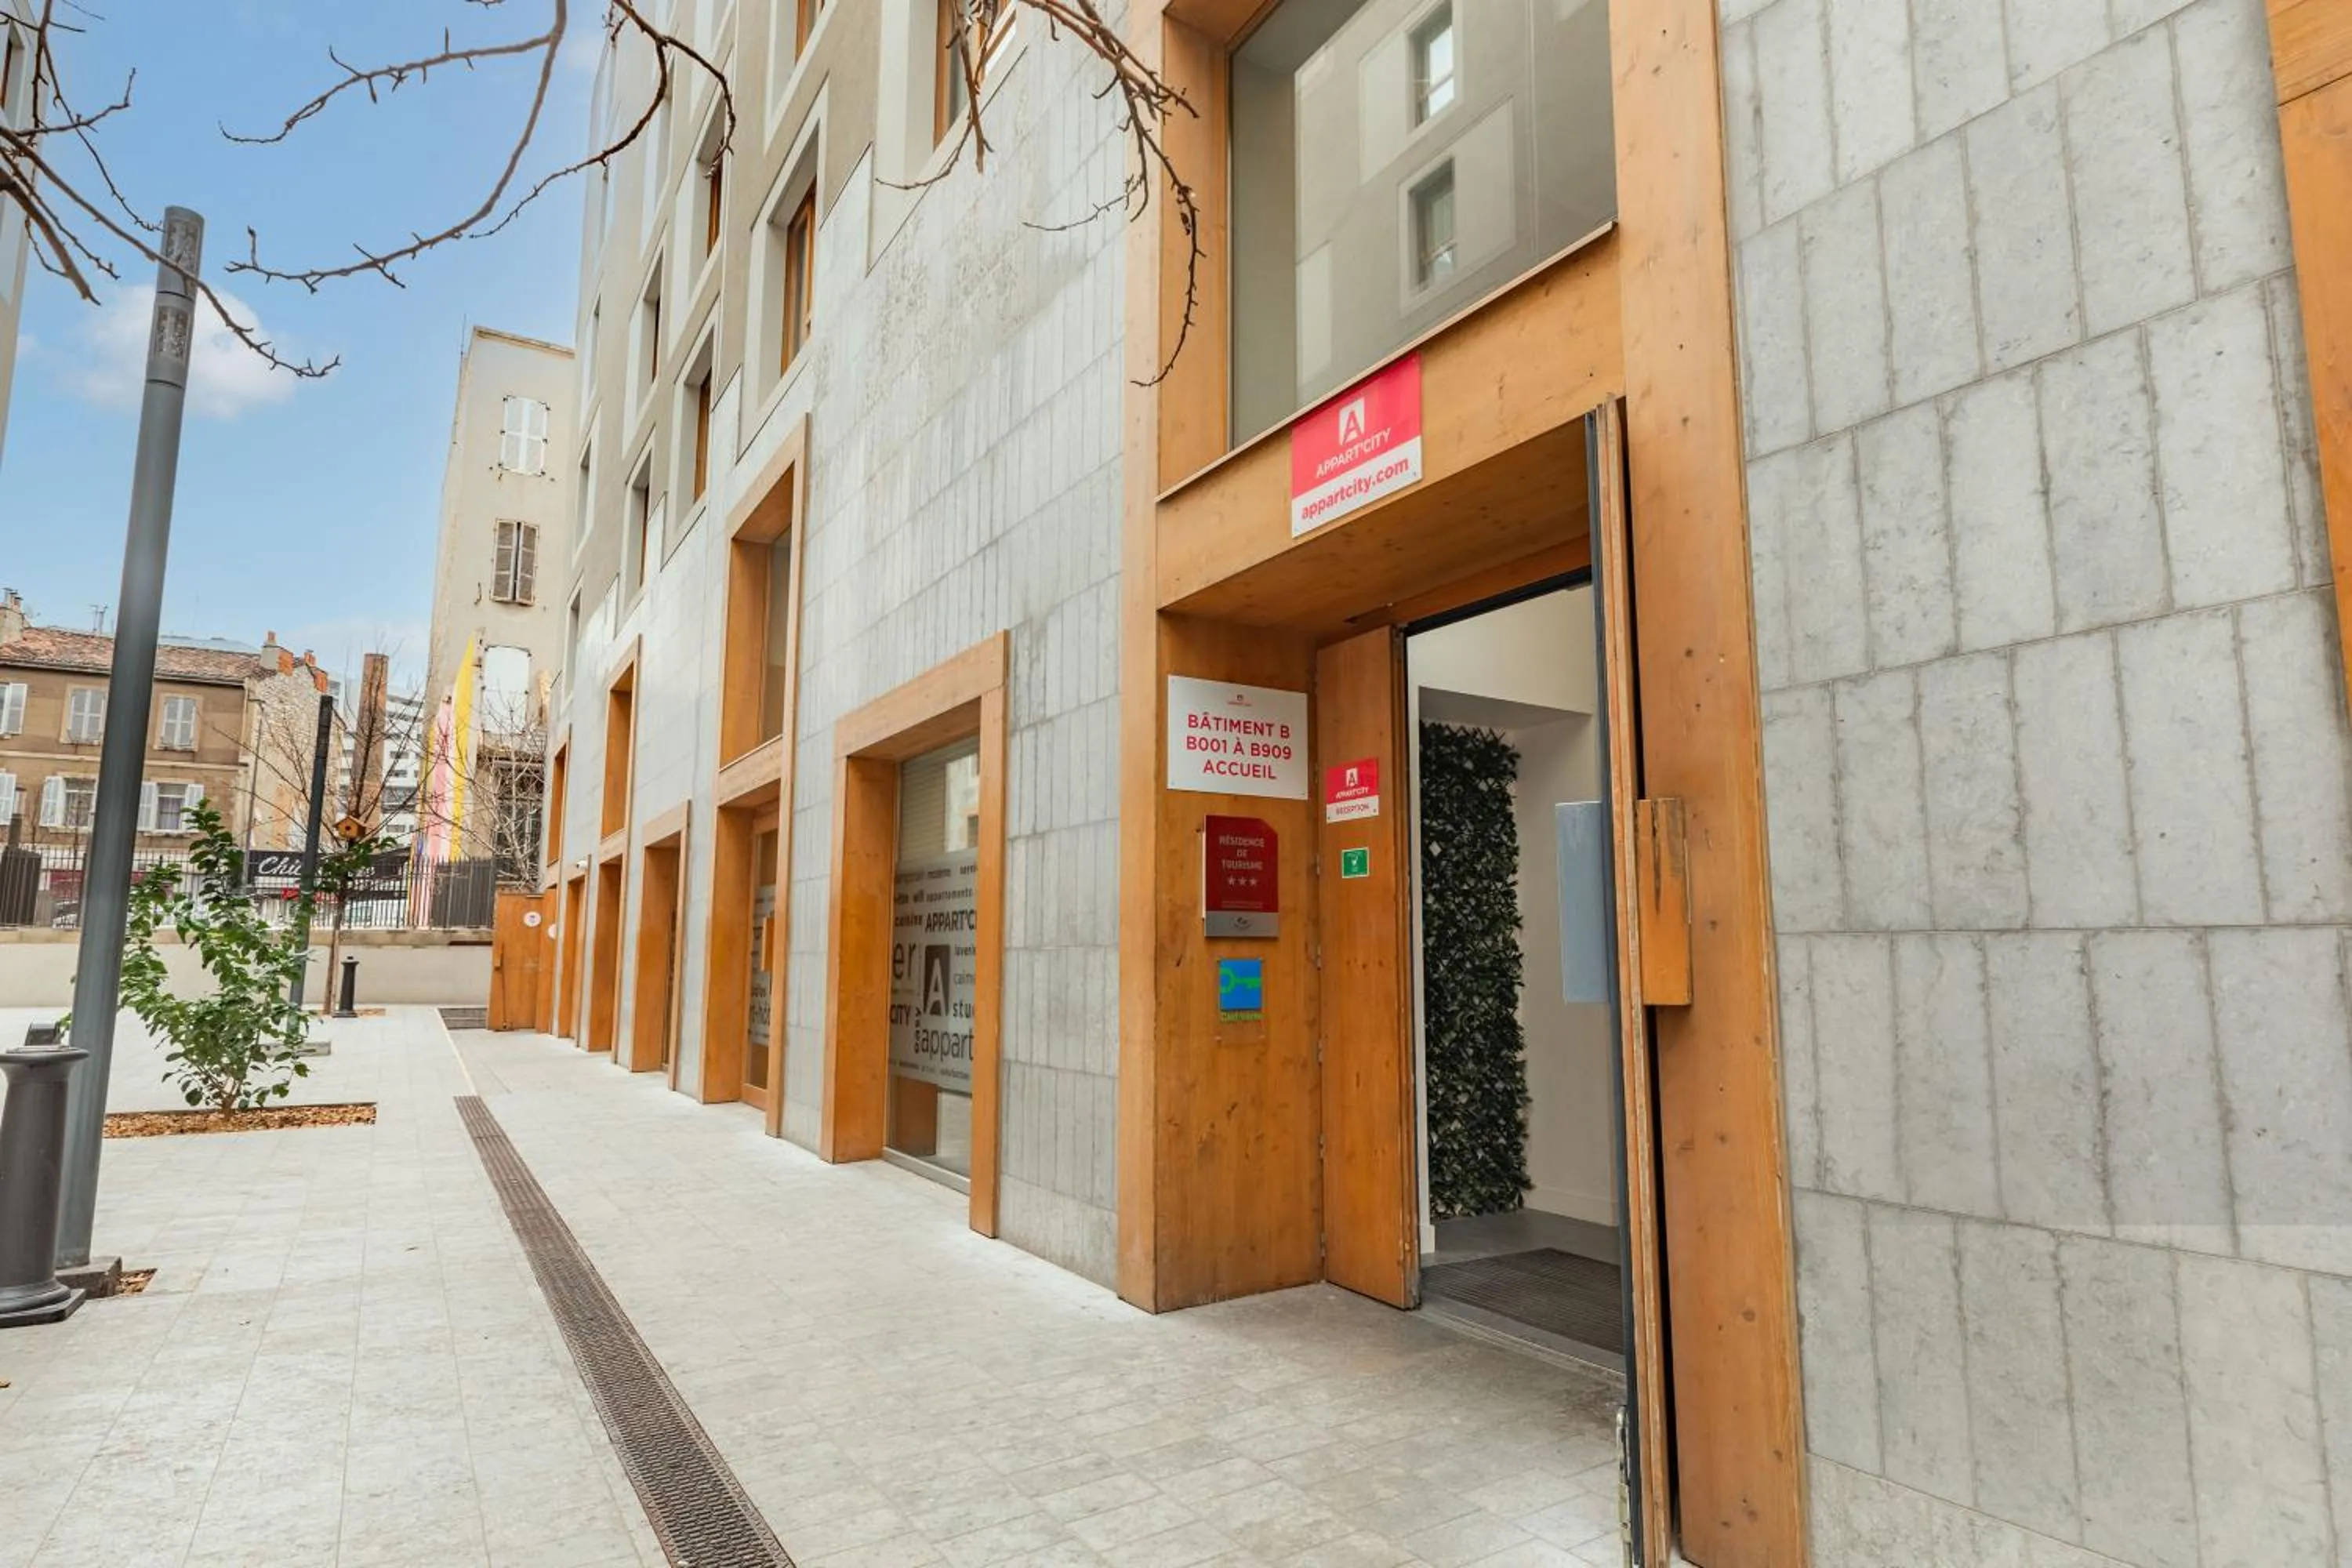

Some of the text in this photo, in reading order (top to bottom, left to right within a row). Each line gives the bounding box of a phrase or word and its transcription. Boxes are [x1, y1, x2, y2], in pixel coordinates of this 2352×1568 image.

[1316, 428, 1392, 479] APPART'CITY
[1301, 458, 1410, 520] appartcity.com
[1188, 712, 1290, 739] BÂTIMENT B
[1186, 736, 1292, 760] B001 À B909
[1203, 759, 1277, 780] ACCUEIL
[1219, 834, 1265, 848] RÉSIDENCE
[1236, 849, 1249, 858] DE
[1221, 859, 1264, 871] TOURISME
